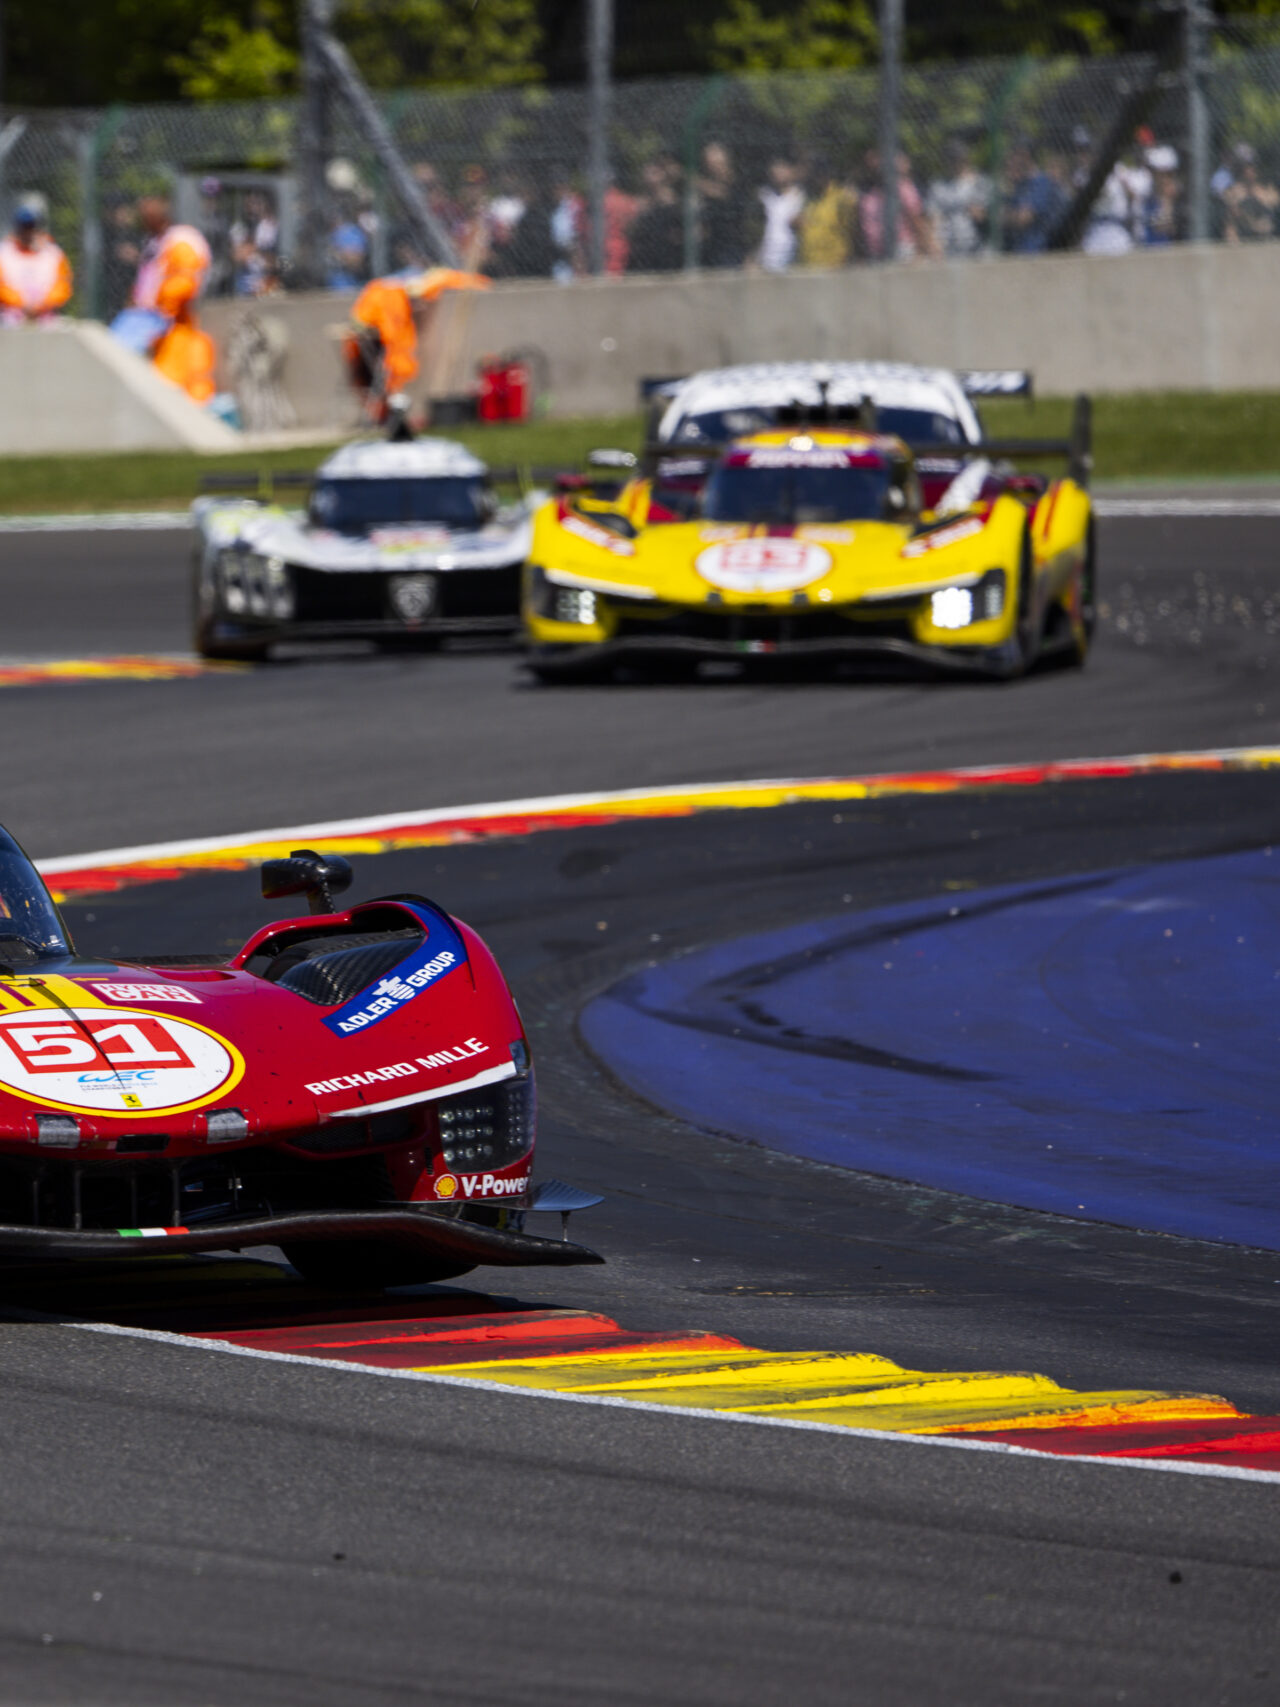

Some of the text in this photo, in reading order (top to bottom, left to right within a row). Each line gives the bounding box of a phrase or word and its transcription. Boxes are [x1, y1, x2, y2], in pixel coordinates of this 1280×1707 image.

[110, 990, 194, 1001] CAR
[337, 951, 456, 1033] ADLER GROUP
[6, 1024, 182, 1066] 51
[78, 1070, 156, 1082] WEC
[304, 1038, 489, 1095] RICHARD MILLE
[462, 1175, 529, 1197] V-Power
